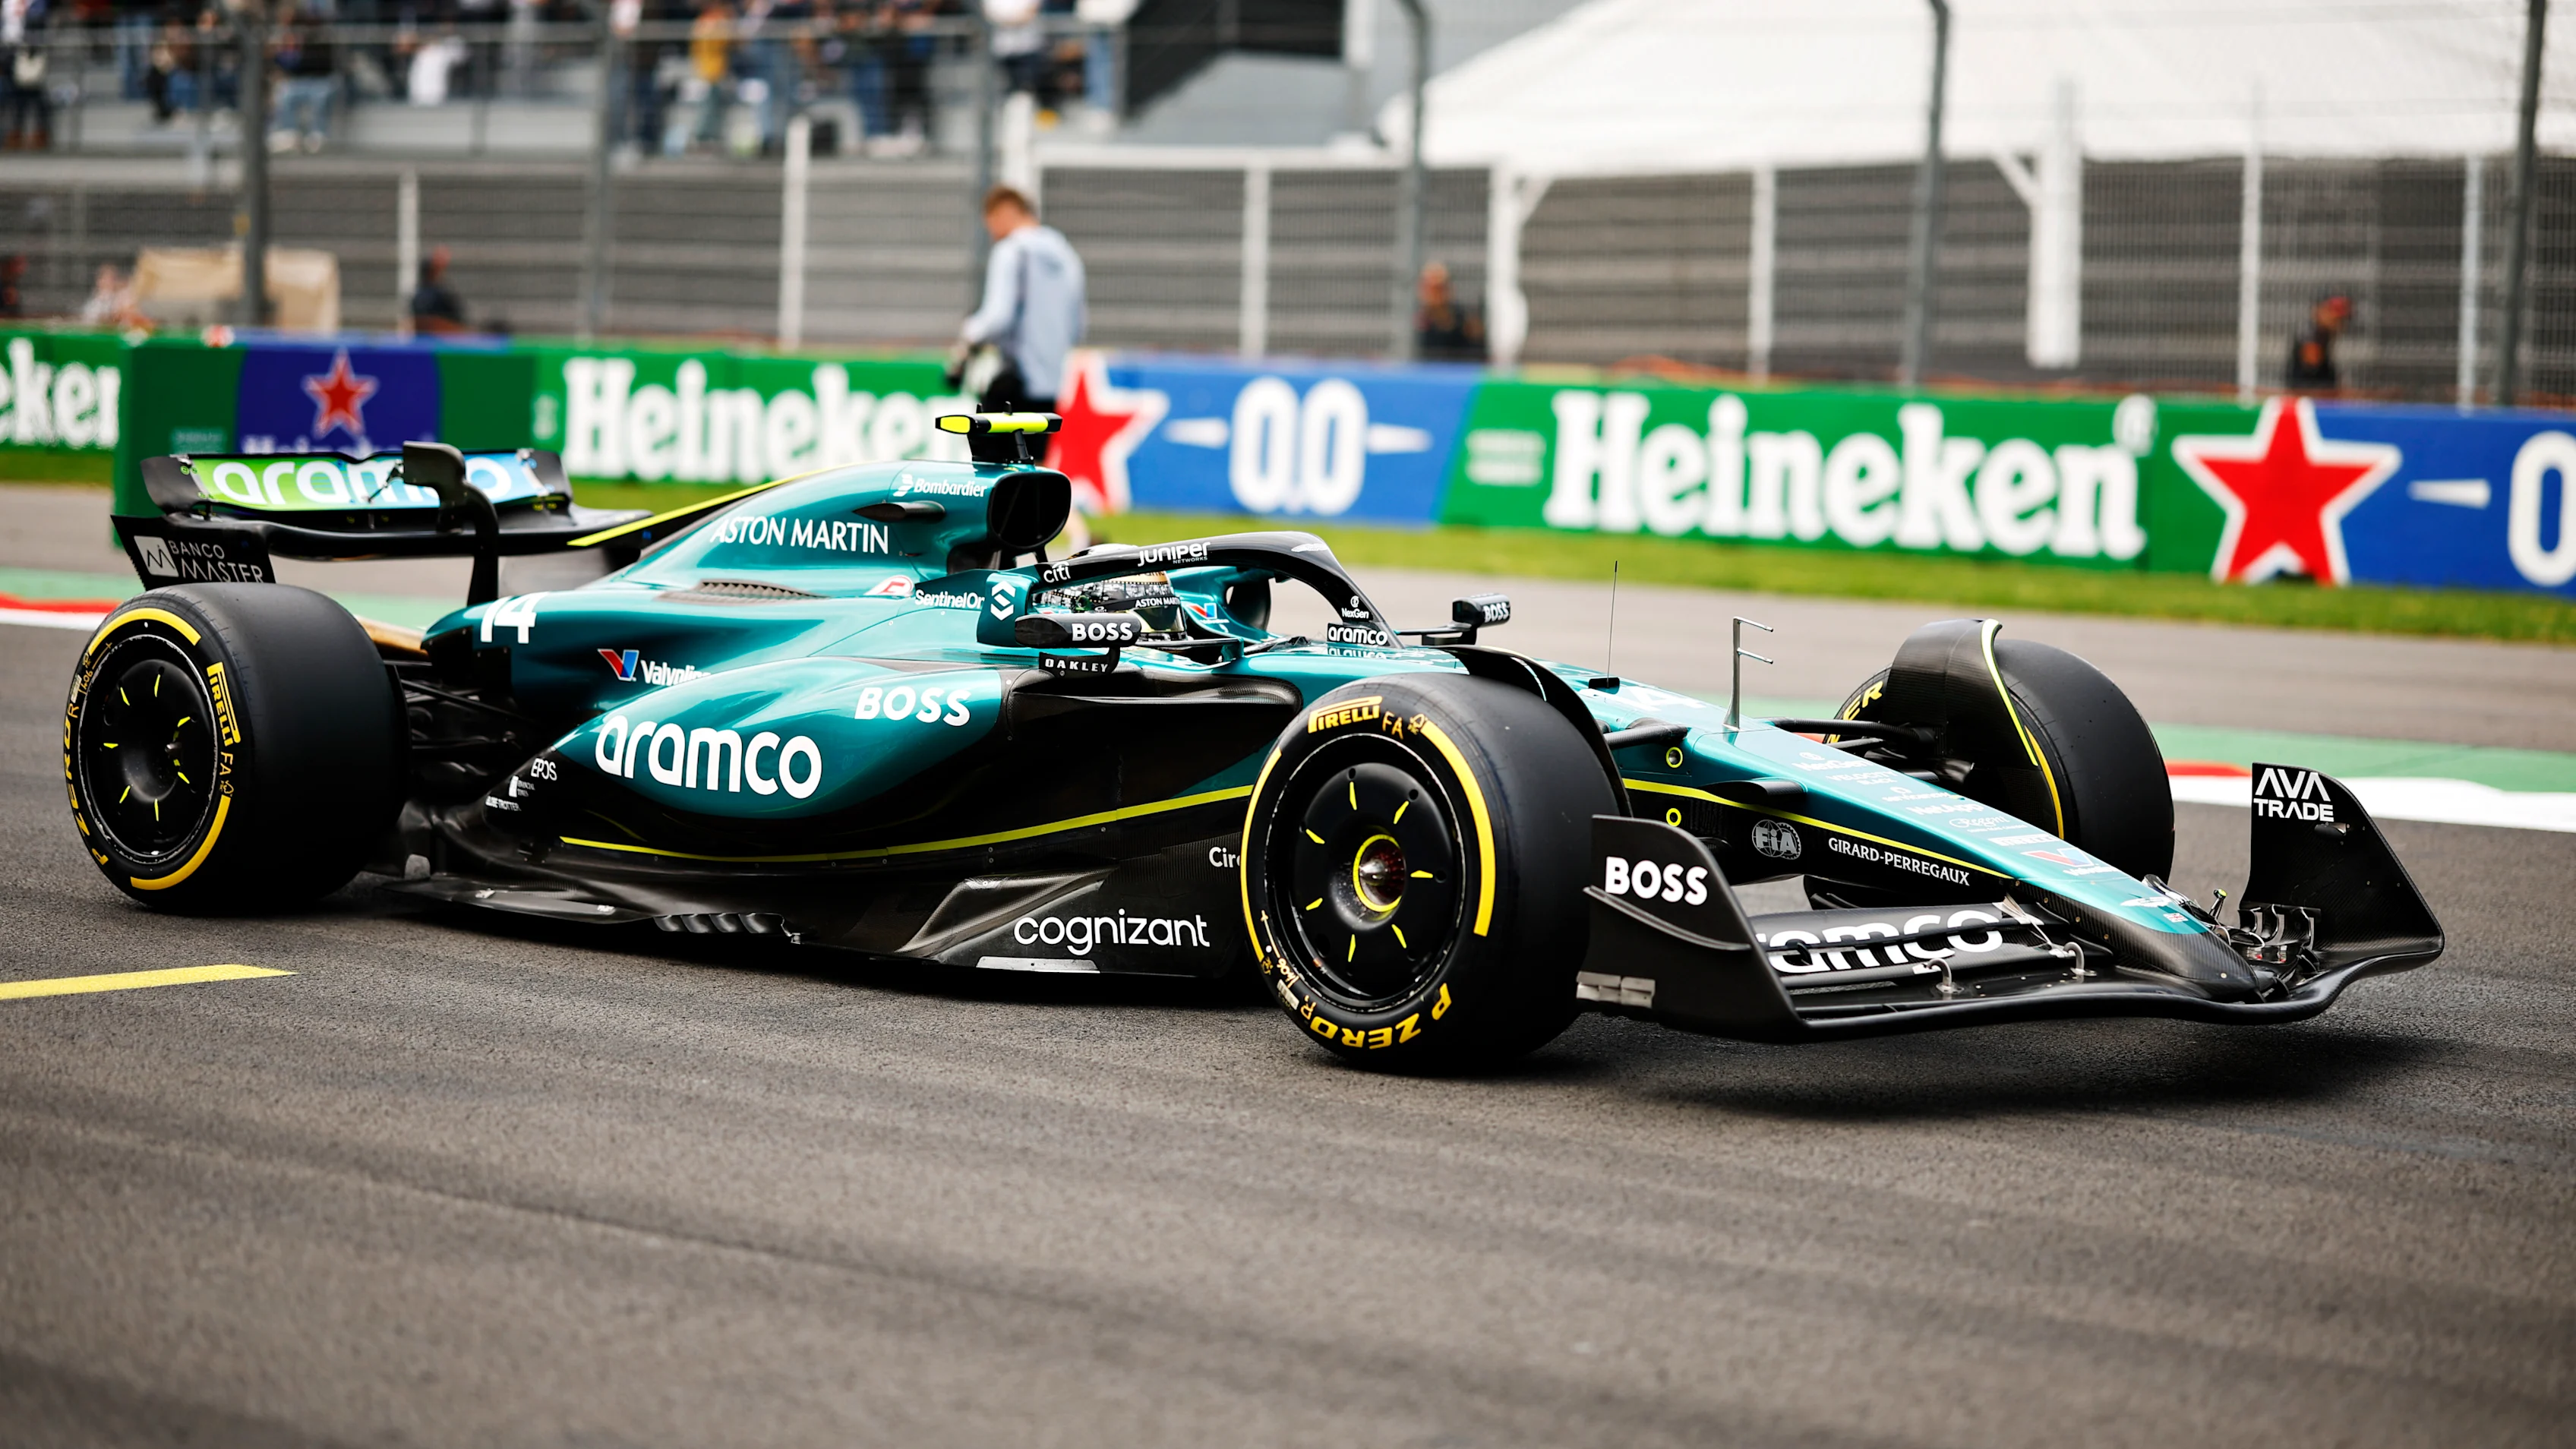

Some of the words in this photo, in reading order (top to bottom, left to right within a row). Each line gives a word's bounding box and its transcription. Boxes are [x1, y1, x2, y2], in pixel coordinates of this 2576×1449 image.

[213, 457, 513, 506] aramo
[913, 478, 987, 497] Bombardier
[1542, 389, 2148, 560] Heineken
[168, 540, 225, 560] BANCO
[710, 516, 786, 545] ASTON
[790, 519, 889, 554] MARTIN
[181, 557, 264, 583] MASTER
[1043, 560, 1071, 583] citi
[1173, 556, 1208, 564] NETWORKS
[481, 592, 550, 644] 14
[1135, 598, 1163, 608] ASTON
[1342, 608, 1369, 619] NexGen
[1482, 601, 1510, 623] BOSS
[1071, 622, 1133, 642] BOSS
[1328, 626, 1388, 646] aramco
[1045, 658, 1108, 674] OAKLEY
[207, 661, 241, 747] PIRELLI
[854, 685, 971, 727] BOSS
[1308, 695, 1383, 734] PIRELLI
[595, 715, 822, 799] aramco
[2255, 767, 2331, 802] AVA
[2253, 798, 2334, 822] TRADE
[1828, 837, 1971, 887] GIRARD-PERREGAUX
[1605, 856, 1709, 907] BOSS
[1014, 908, 1211, 956] cognizant
[1755, 910, 2003, 974] amco
[1432, 983, 1452, 1021] P
[1309, 1015, 1422, 1050] ZERO
